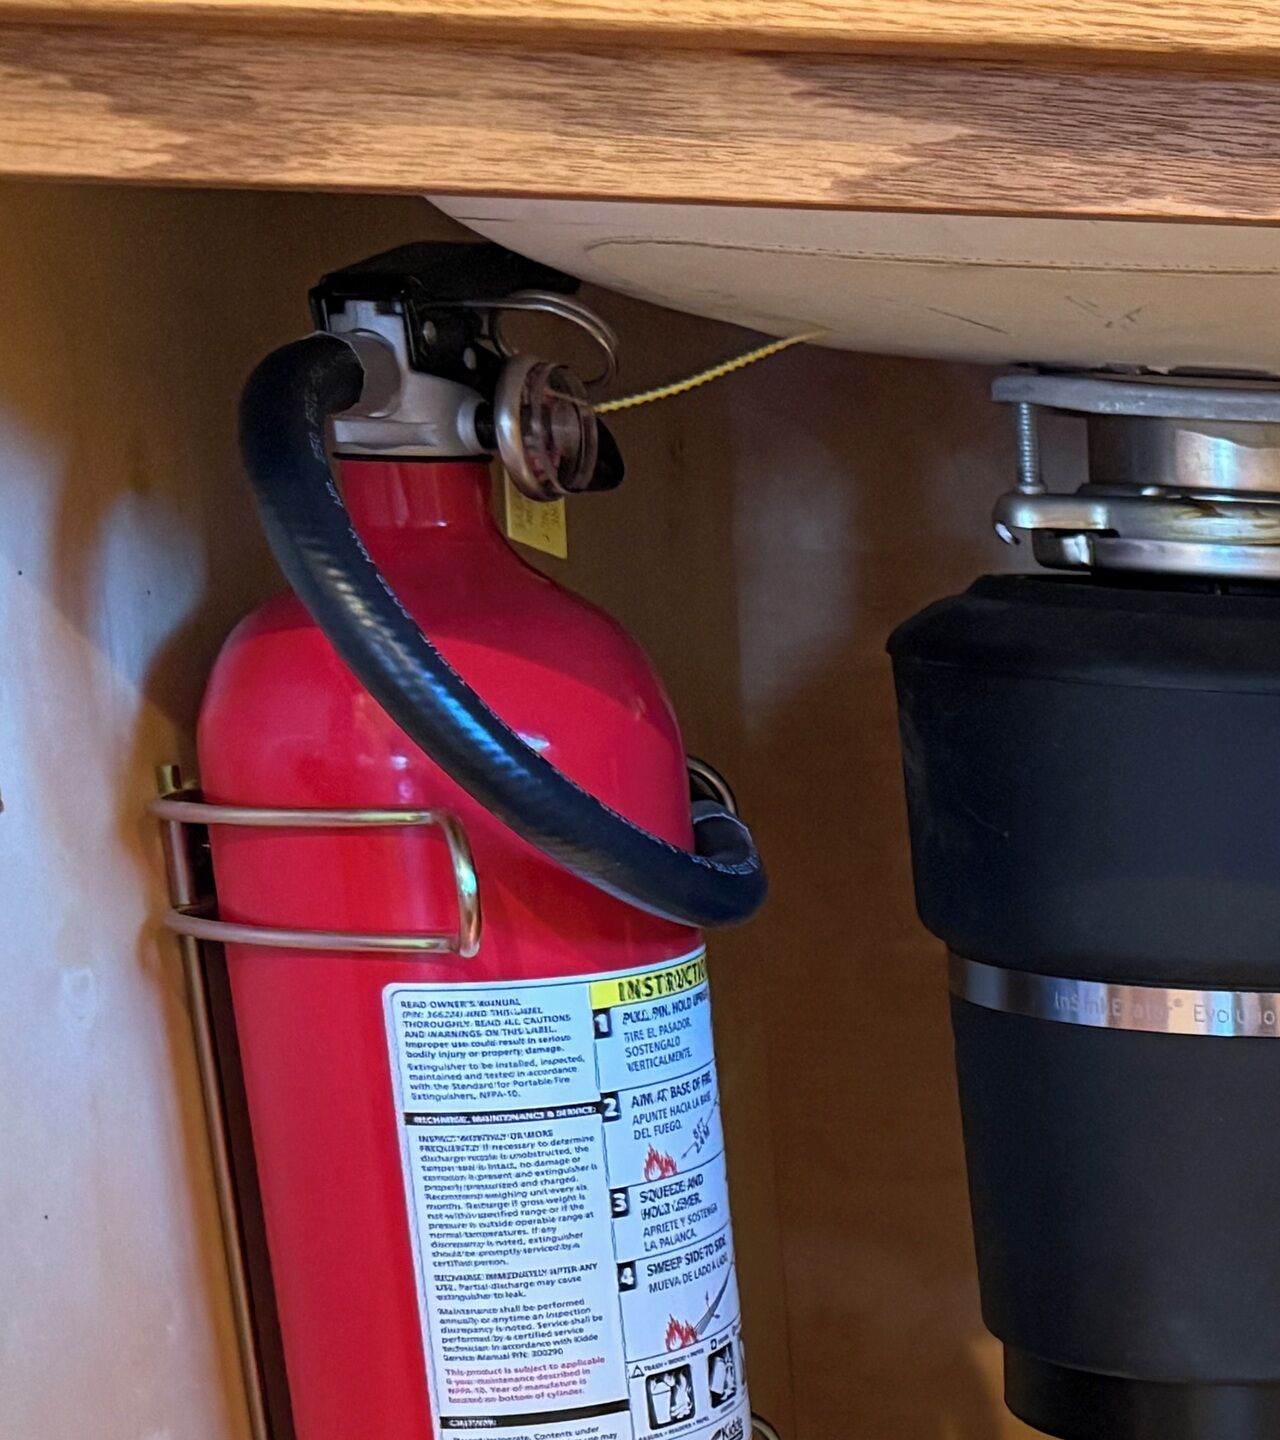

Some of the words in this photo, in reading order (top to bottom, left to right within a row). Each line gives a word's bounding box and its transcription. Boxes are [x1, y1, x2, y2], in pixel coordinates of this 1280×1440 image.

[672, 996, 693, 1014] HOLD
[593, 1012, 609, 1034] 1
[405, 1040, 448, 1051] Improper
[471, 1039, 496, 1048] could
[499, 1037, 525, 1046] result
[527, 1037, 537, 1045] in
[538, 1034, 572, 1043] serious
[624, 1029, 645, 1044] TIRE
[647, 1027, 658, 1038] EL
[406, 1049, 437, 1060] bodily
[438, 1048, 466, 1060] injury
[481, 1048, 522, 1059] property
[525, 1045, 566, 1056] damage.
[624, 1035, 681, 1058] SOSTENGALO
[631, 1091, 654, 1109] AIM
[669, 1080, 691, 1098] BASE
[692, 1076, 702, 1091] OF
[602, 1097, 619, 1118] 2
[633, 1107, 668, 1126] APUNTE
[670, 1099, 692, 1118] HACIA
[692, 1096, 701, 1109] LA
[633, 1125, 651, 1141] DEL
[639, 1179, 687, 1204] SQUEEZE
[686, 1173, 704, 1190] AND
[613, 1192, 627, 1213] 3
[641, 1202, 670, 1221] HOLD
[643, 1220, 680, 1239] APRIETE
[680, 1217, 687, 1229] Y
[687, 1202, 719, 1225] SOSTENGA
[644, 1239, 658, 1253] LA
[646, 1256, 684, 1278] SWEEP
[684, 1249, 704, 1267] SIDE
[703, 1243, 714, 1258] TO
[620, 1267, 634, 1286] 4
[648, 1276, 682, 1294] MUEVA
[682, 1272, 694, 1283] DE
[694, 1263, 712, 1280] LADO
[711, 1260, 718, 1272] A
